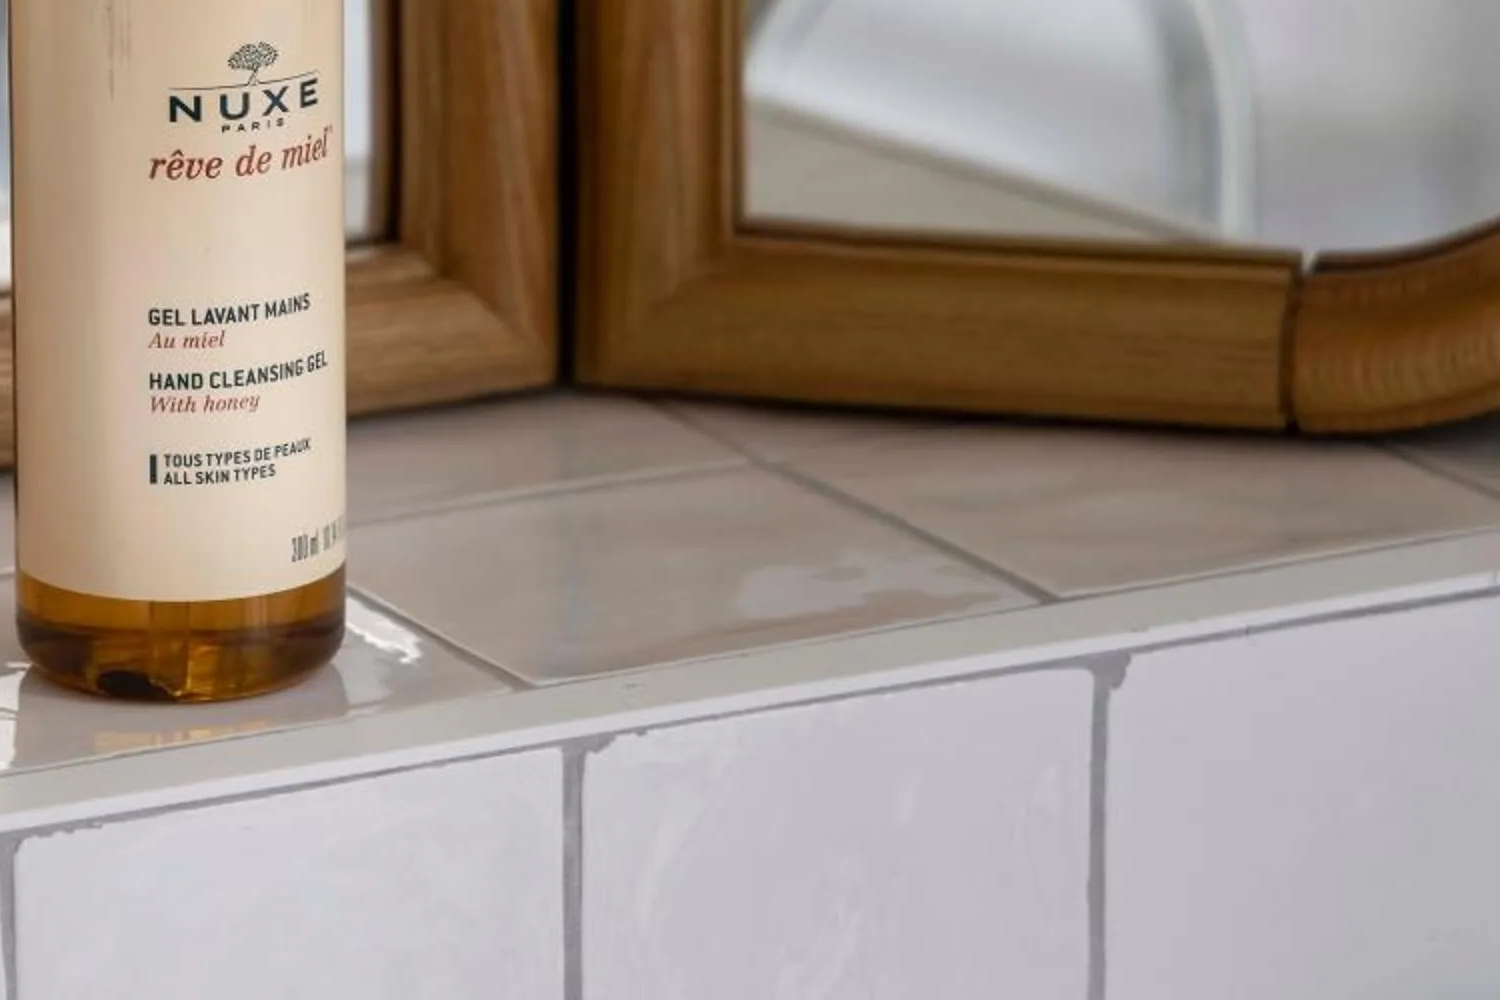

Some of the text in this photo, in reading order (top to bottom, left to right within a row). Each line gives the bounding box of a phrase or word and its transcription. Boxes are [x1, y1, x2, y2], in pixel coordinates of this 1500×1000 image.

[169, 77, 319, 123] NUXE
[221, 117, 285, 133] PARIS
[149, 149, 223, 181] rêve
[235, 144, 273, 177] de
[148, 292, 311, 326] GEL LAVANT MAINS
[148, 330, 226, 349] Au miel
[149, 350, 328, 391] HAND CLEANSING GEL
[149, 394, 261, 414] With honey
[164, 437, 312, 468] TOUS TYPES DE PEAUX
[163, 463, 276, 486] ALL SKIN TYPES
